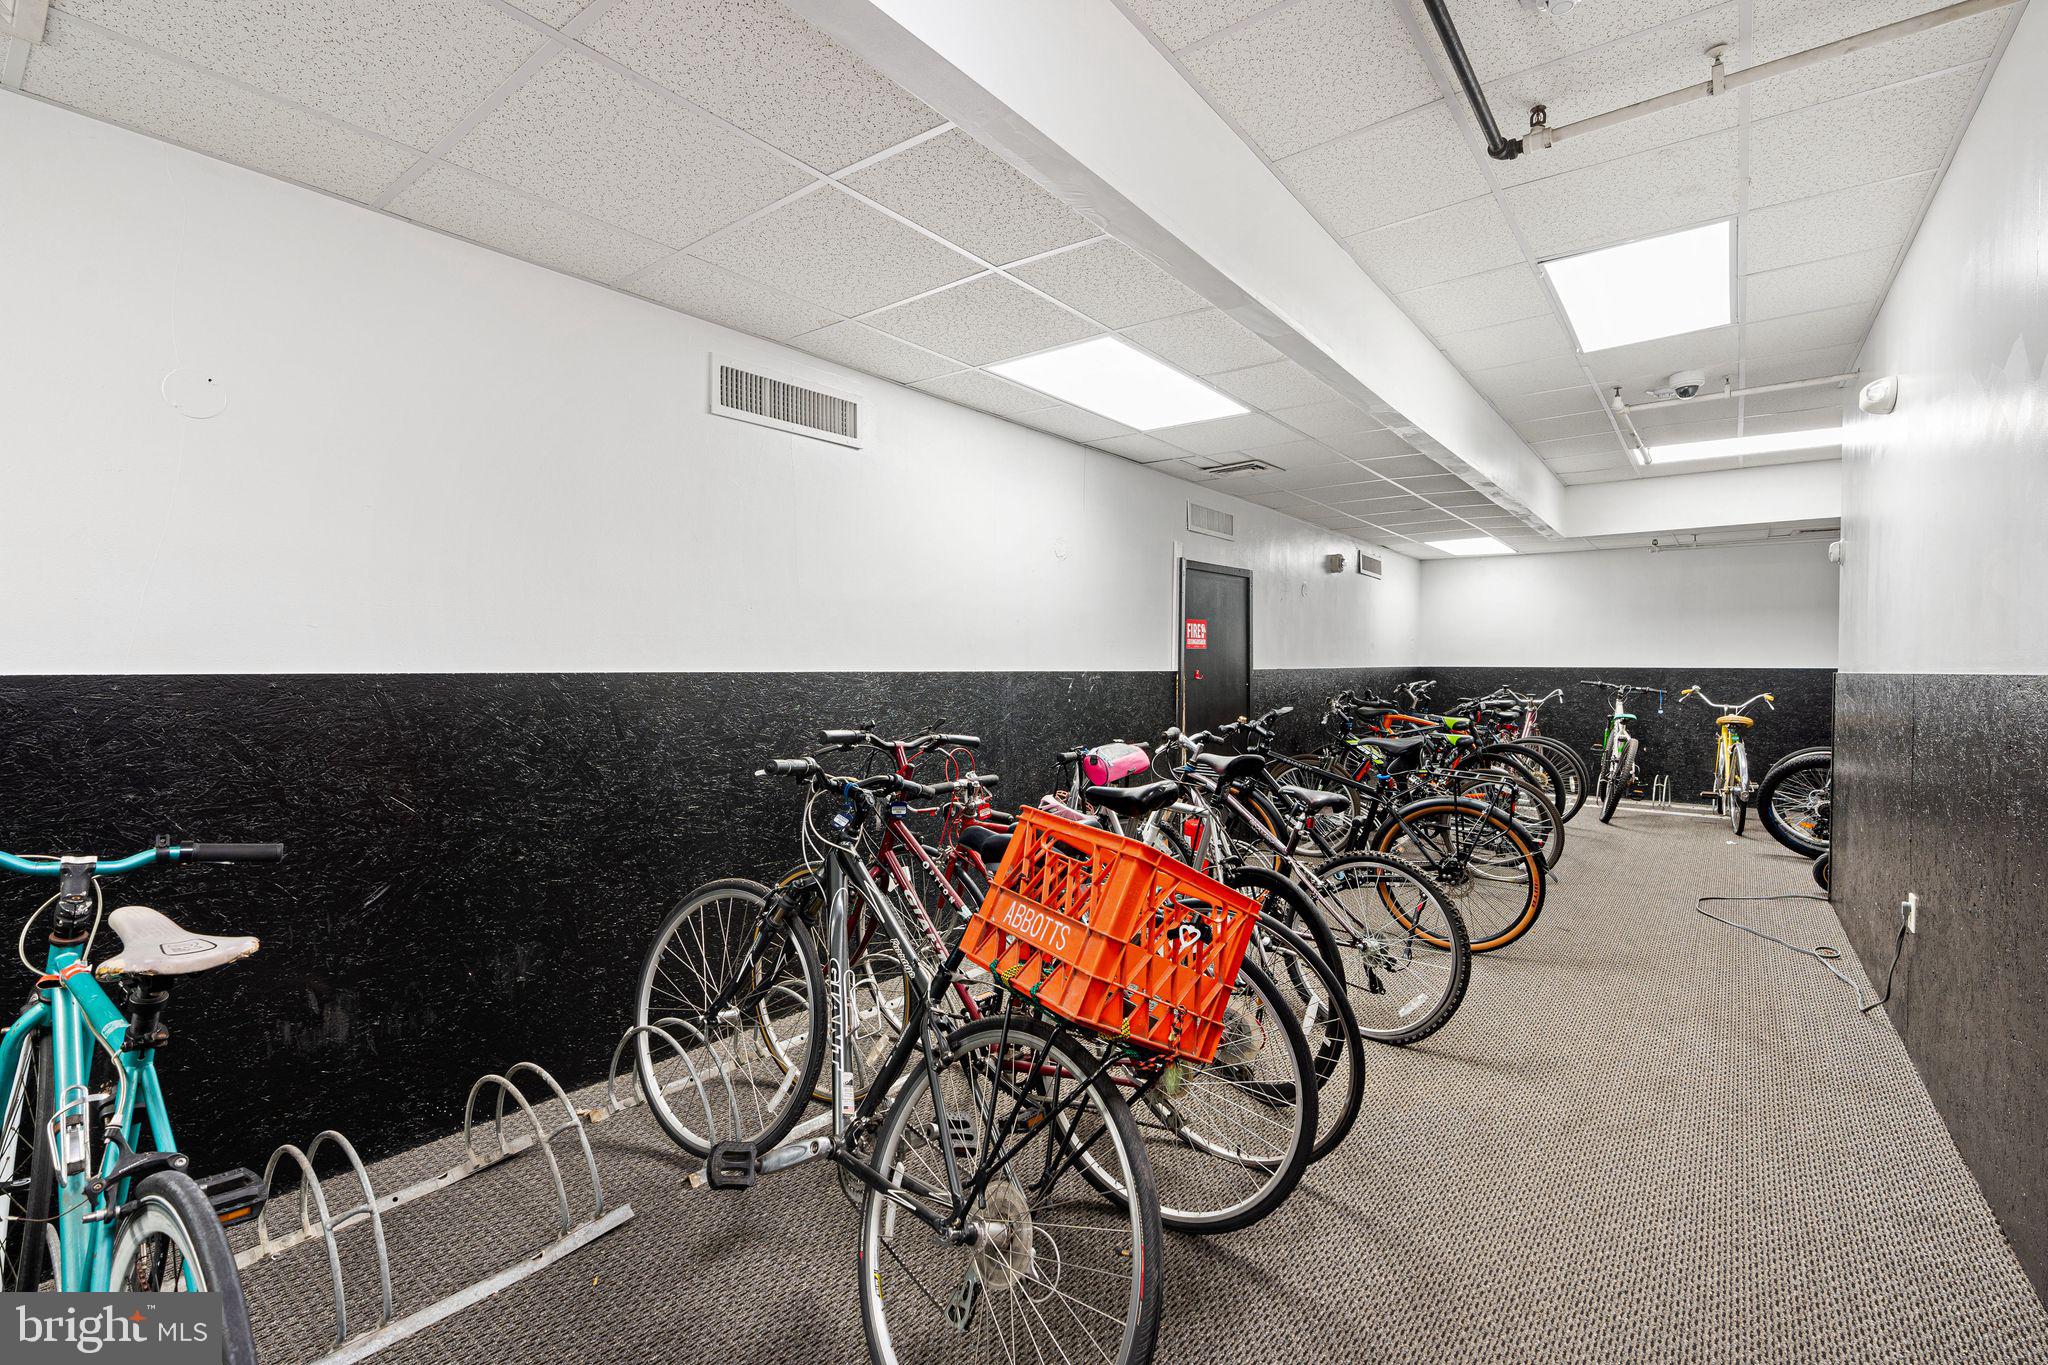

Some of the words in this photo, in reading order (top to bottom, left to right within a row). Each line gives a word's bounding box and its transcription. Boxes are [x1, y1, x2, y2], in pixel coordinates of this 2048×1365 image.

[1186, 623, 1201, 639] FIRE
[922, 861, 955, 904] OPTION
[1002, 900, 1071, 951] ABBOTTS
[830, 957, 844, 1072] GIANT
